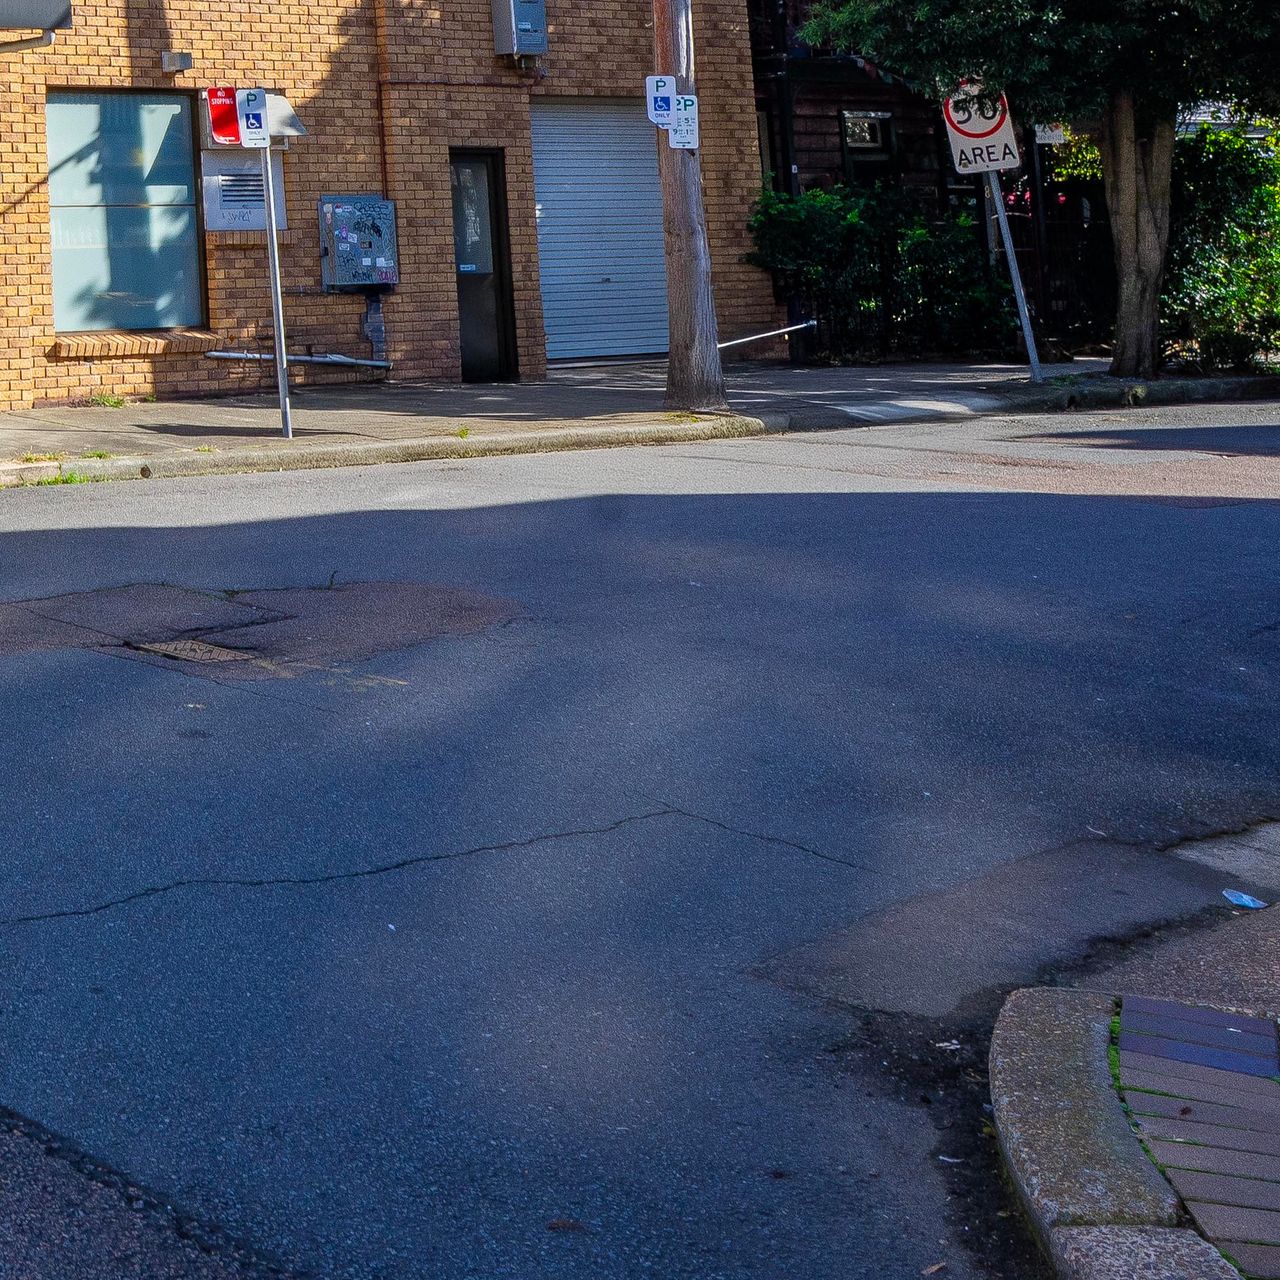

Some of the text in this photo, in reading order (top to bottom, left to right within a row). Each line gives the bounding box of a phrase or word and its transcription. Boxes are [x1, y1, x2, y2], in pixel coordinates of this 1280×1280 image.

[655, 80, 666, 92] P
[211, 97, 234, 105] STOPPING
[246, 93, 257, 107] P
[958, 143, 1017, 167] AREA
